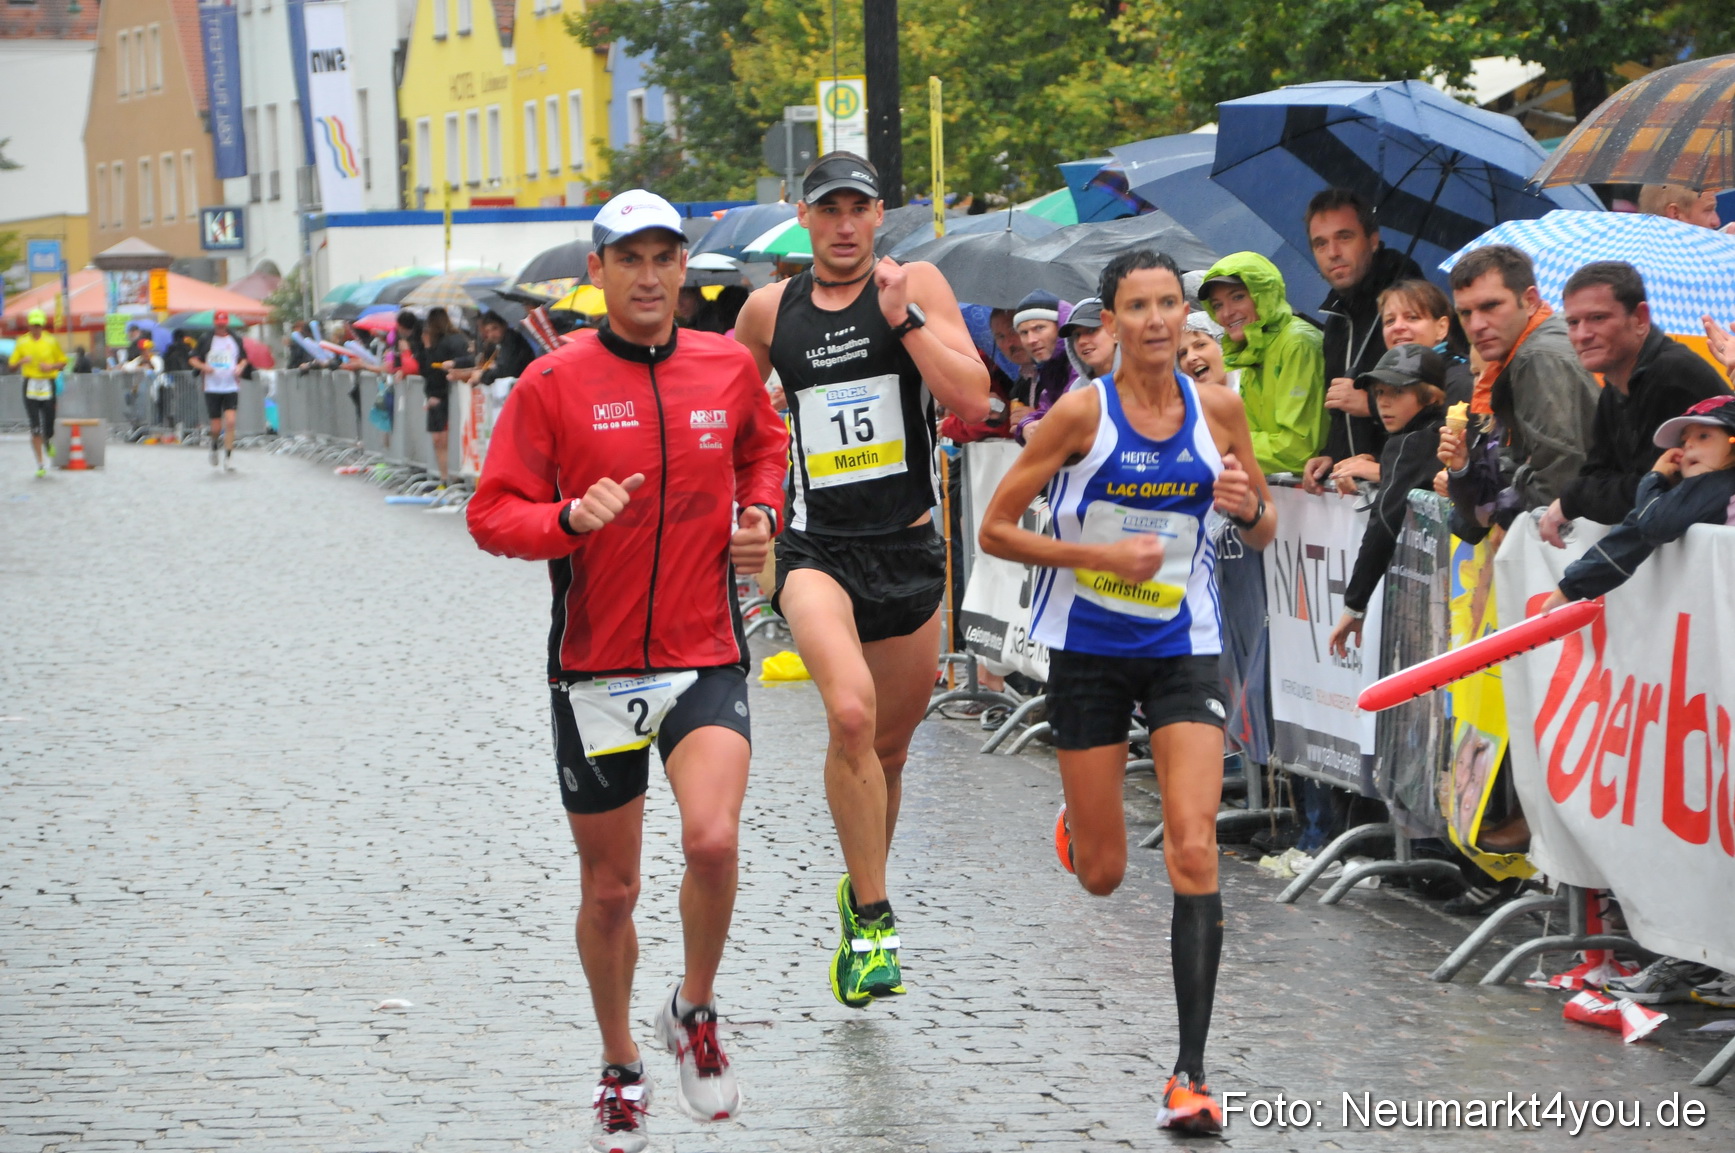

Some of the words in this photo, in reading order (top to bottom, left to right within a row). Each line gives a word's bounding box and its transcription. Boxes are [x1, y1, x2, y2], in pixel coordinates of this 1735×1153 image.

[805, 346, 826, 359] LLC
[826, 337, 870, 354] Marathon
[811, 348, 868, 368] Regensburg
[826, 385, 867, 401] BOCK
[592, 400, 635, 420] HDI
[690, 409, 727, 423] ARNDT
[592, 422, 609, 431] TSG
[621, 419, 640, 428] Roth
[830, 406, 875, 446] 15
[699, 441, 723, 449] skinfit
[834, 450, 879, 469] Martin
[1121, 451, 1160, 464] HEITEC
[1106, 482, 1137, 497] LAC
[1140, 482, 1199, 498] QUELLE
[1093, 575, 1160, 603] Christine
[627, 697, 653, 736] 2
